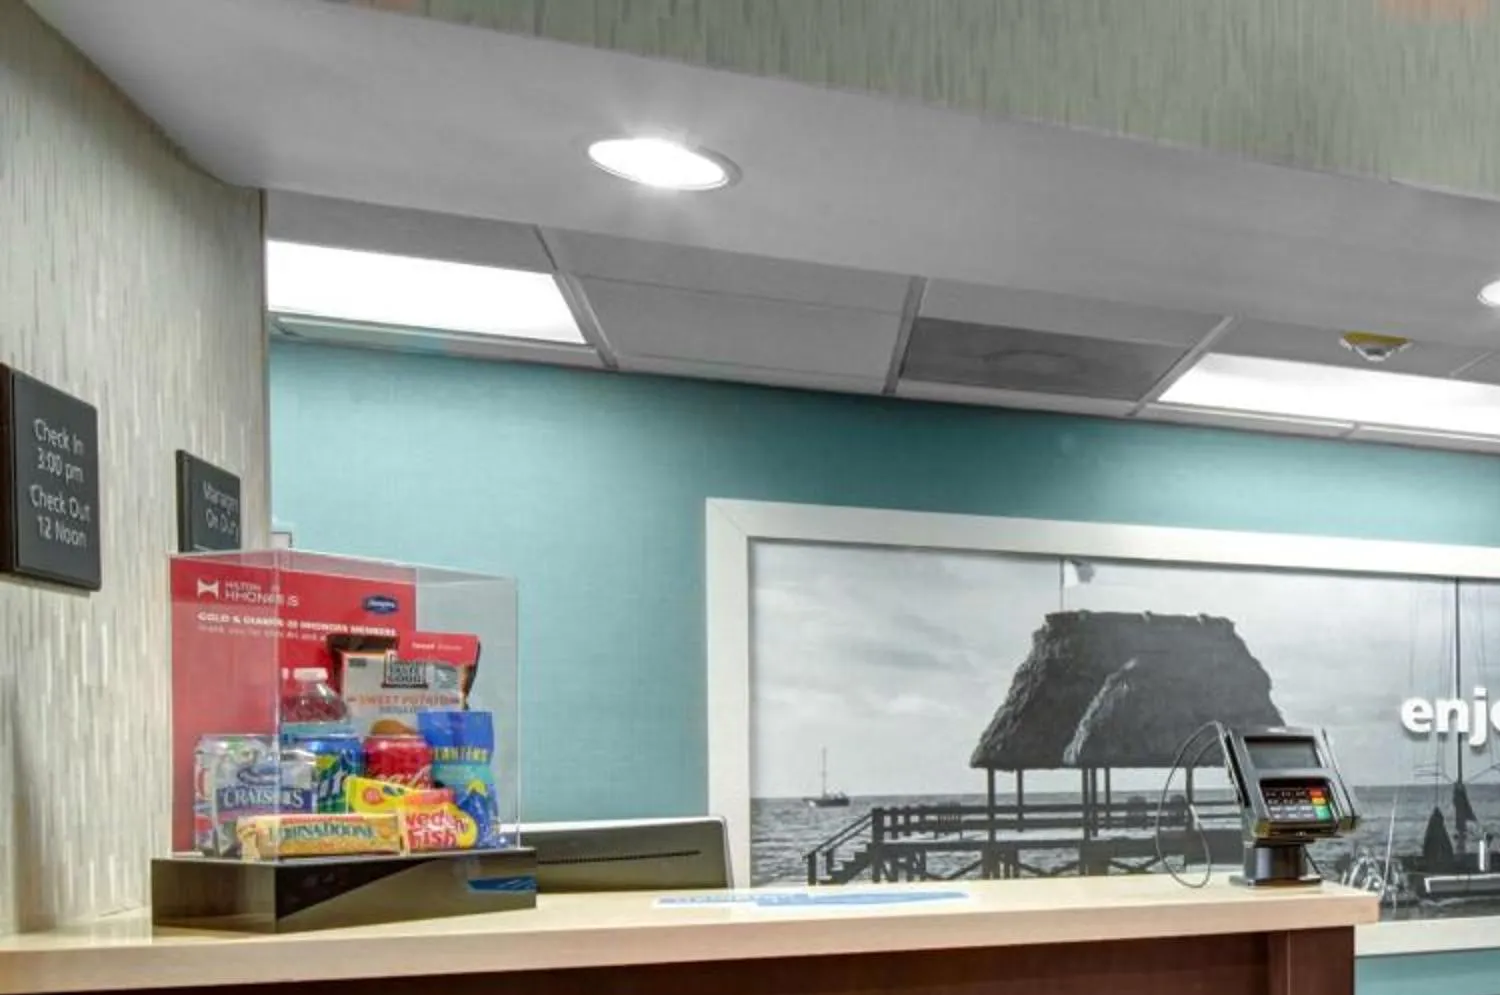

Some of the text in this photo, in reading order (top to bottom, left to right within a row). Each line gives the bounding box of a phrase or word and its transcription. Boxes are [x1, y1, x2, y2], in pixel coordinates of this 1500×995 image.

[33, 418, 85, 456] Check In
[37, 447, 84, 486] 3:00 pm
[30, 484, 91, 523] Check Out
[37, 515, 88, 549] 12 Noon
[223, 785, 305, 808] CRAISS
